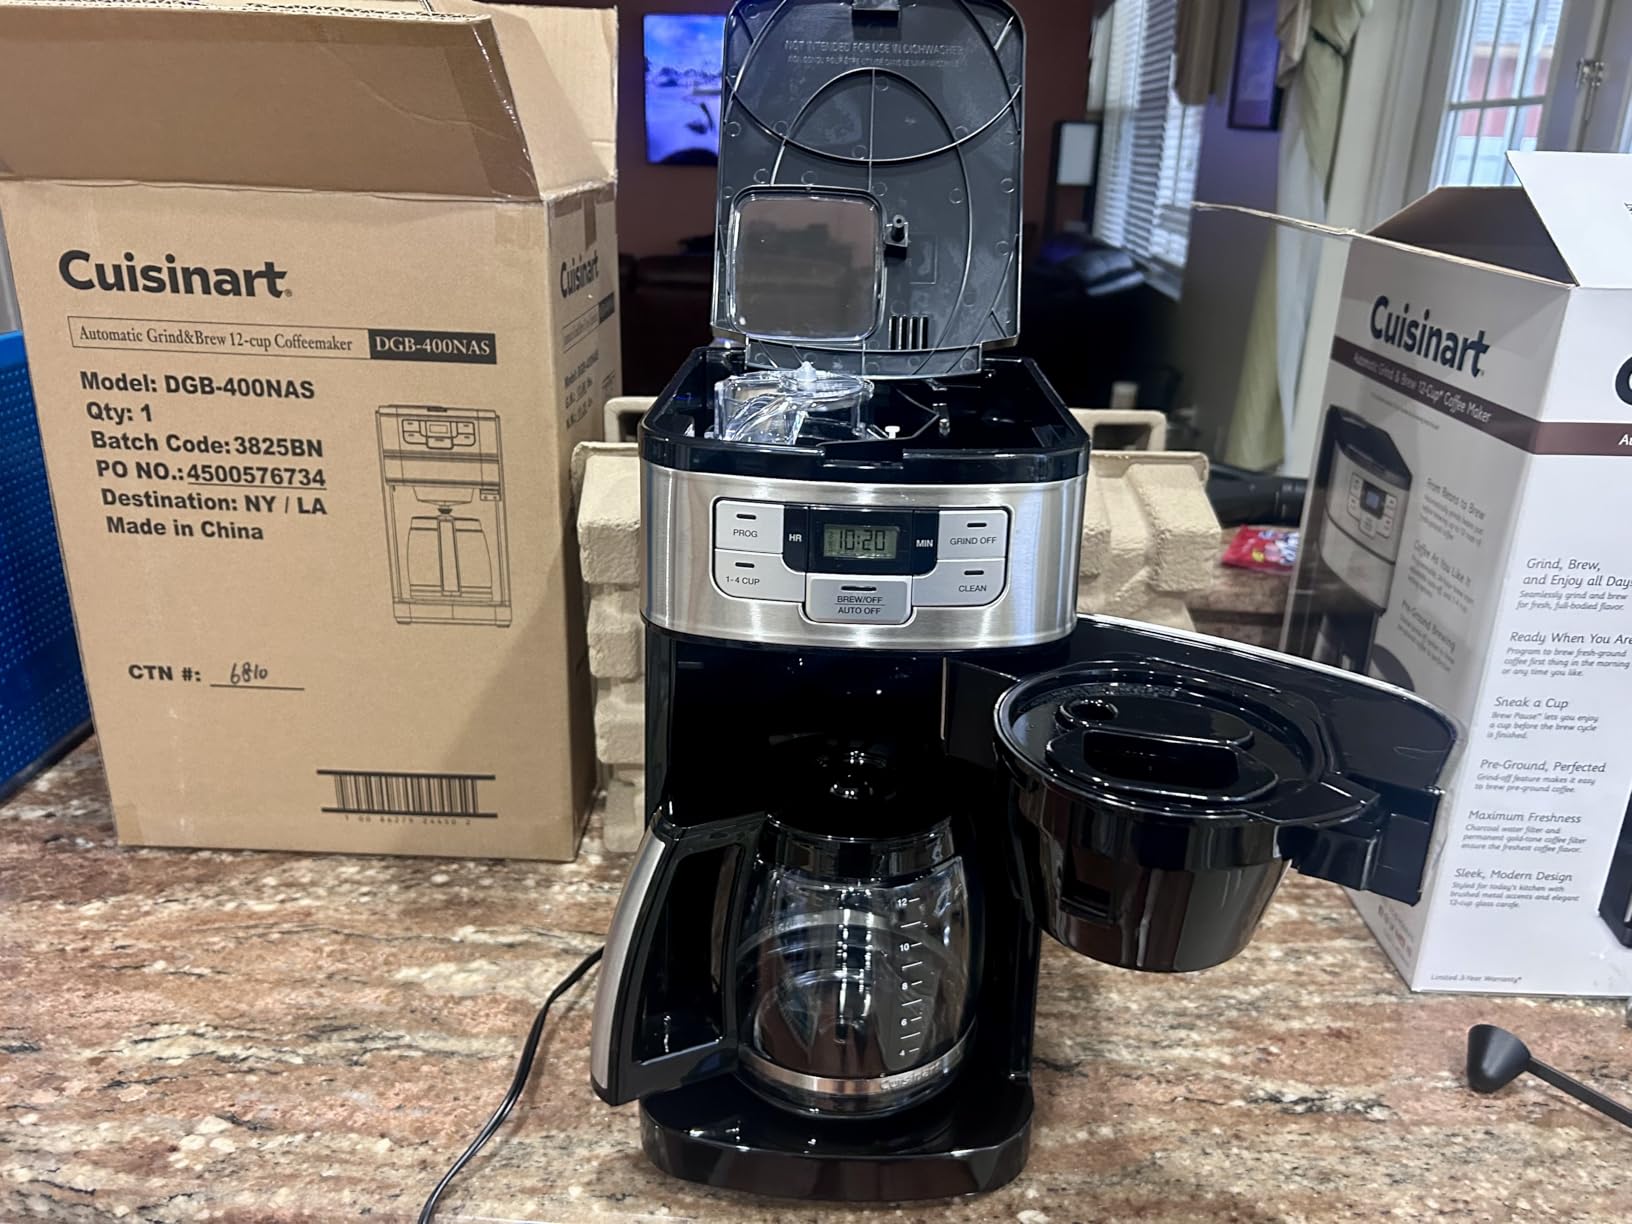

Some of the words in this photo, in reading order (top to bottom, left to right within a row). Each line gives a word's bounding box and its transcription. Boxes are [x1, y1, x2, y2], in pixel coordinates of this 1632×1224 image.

[853, 42, 871, 54] FOR
[872, 42, 890, 54] USE
[59, 250, 288, 298] Cuisinart
[560, 250, 599, 298] Cuisinart
[80, 326, 143, 342] Automatic
[146, 328, 226, 346] Grind&Brew
[229, 332, 271, 352] 12-cup
[274, 334, 352, 351] Coffeemaker
[1370, 295, 1490, 378] Cuisinart
[375, 336, 490, 355] DGB-400NAS
[80, 371, 158, 392] Model:
[164, 375, 314, 399] DGB-400NAS
[1444, 392, 1466, 413] Coffee
[1466, 402, 1492, 422] Maker
[87, 402, 134, 425] Qty:
[141, 404, 152, 422] 1
[91, 430, 158, 450] Batch
[96, 460, 128, 478] PO
[101, 488, 238, 512] Destination:
[244, 495, 276, 512] NY
[284, 496, 290, 514] /
[298, 497, 328, 515] LA
[106, 516, 166, 536] Made
[174, 520, 194, 537] in
[201, 521, 264, 540] China
[733, 529, 758, 538] PROG
[789, 534, 802, 542] HR
[840, 530, 885, 550] 10:20
[916, 539, 934, 548] MIN
[950, 537, 978, 546] GRIND
[980, 536, 997, 545] OFF
[1527, 558, 1563, 571] Grind,
[1568, 559, 1601, 572] Brew,
[742, 577, 760, 586] CUP
[1523, 574, 1547, 585] and
[1550, 575, 1583, 588] Enjoy
[1587, 575, 1602, 586] all
[958, 584, 987, 592] CLEAN
[837, 596, 883, 604] BREW/OFF
[1565, 591, 1587, 600] grind
[1607, 592, 1628, 600] brew
[838, 607, 858, 615] AUTO
[860, 606, 881, 615] OFF
[1516, 601, 1528, 610] for
[1510, 632, 1546, 645] Ready
[1552, 633, 1584, 643] When
[1590, 633, 1610, 644] You
[1506, 648, 1540, 656] Program
[1504, 658, 1527, 666] coffee
[1528, 659, 1546, 667] first
[1548, 659, 1569, 667] thing
[1596, 661, 1630, 669] morning
[128, 664, 173, 681] CTN
[182, 667, 201, 682] #:
[1494, 696, 1530, 708] Sneak
[1545, 698, 1568, 710] Cup
[1560, 714, 1575, 722] you
[1577, 715, 1599, 723] enjoy
[1576, 724, 1597, 732] cycle
[1480, 759, 1548, 772] Pre-Ground,
[1553, 762, 1606, 774] Perfected
[1513, 775, 1540, 783] feature
[1578, 777, 1596, 785] easy
[1485, 783, 1505, 791] brew
[1506, 785, 1550, 793] pre-ground
[1468, 810, 1524, 821] Maximum
[1528, 812, 1582, 823] Freshness
[1465, 824, 1499, 832] Charcoal
[1463, 834, 1504, 842] permanent
[1567, 836, 1586, 845] filter
[1501, 843, 1533, 852] freshest
[1455, 868, 1485, 879] Sleek,
[1490, 870, 1532, 880] Modern
[1536, 871, 1572, 884] Design
[1452, 882, 1475, 890] Styled
[1475, 883, 1488, 891] for
[898, 898, 908, 906] 12
[1551, 894, 1579, 903] elegant
[1475, 901, 1494, 909] glass
[880, 1061, 941, 1090] Cuisinart
